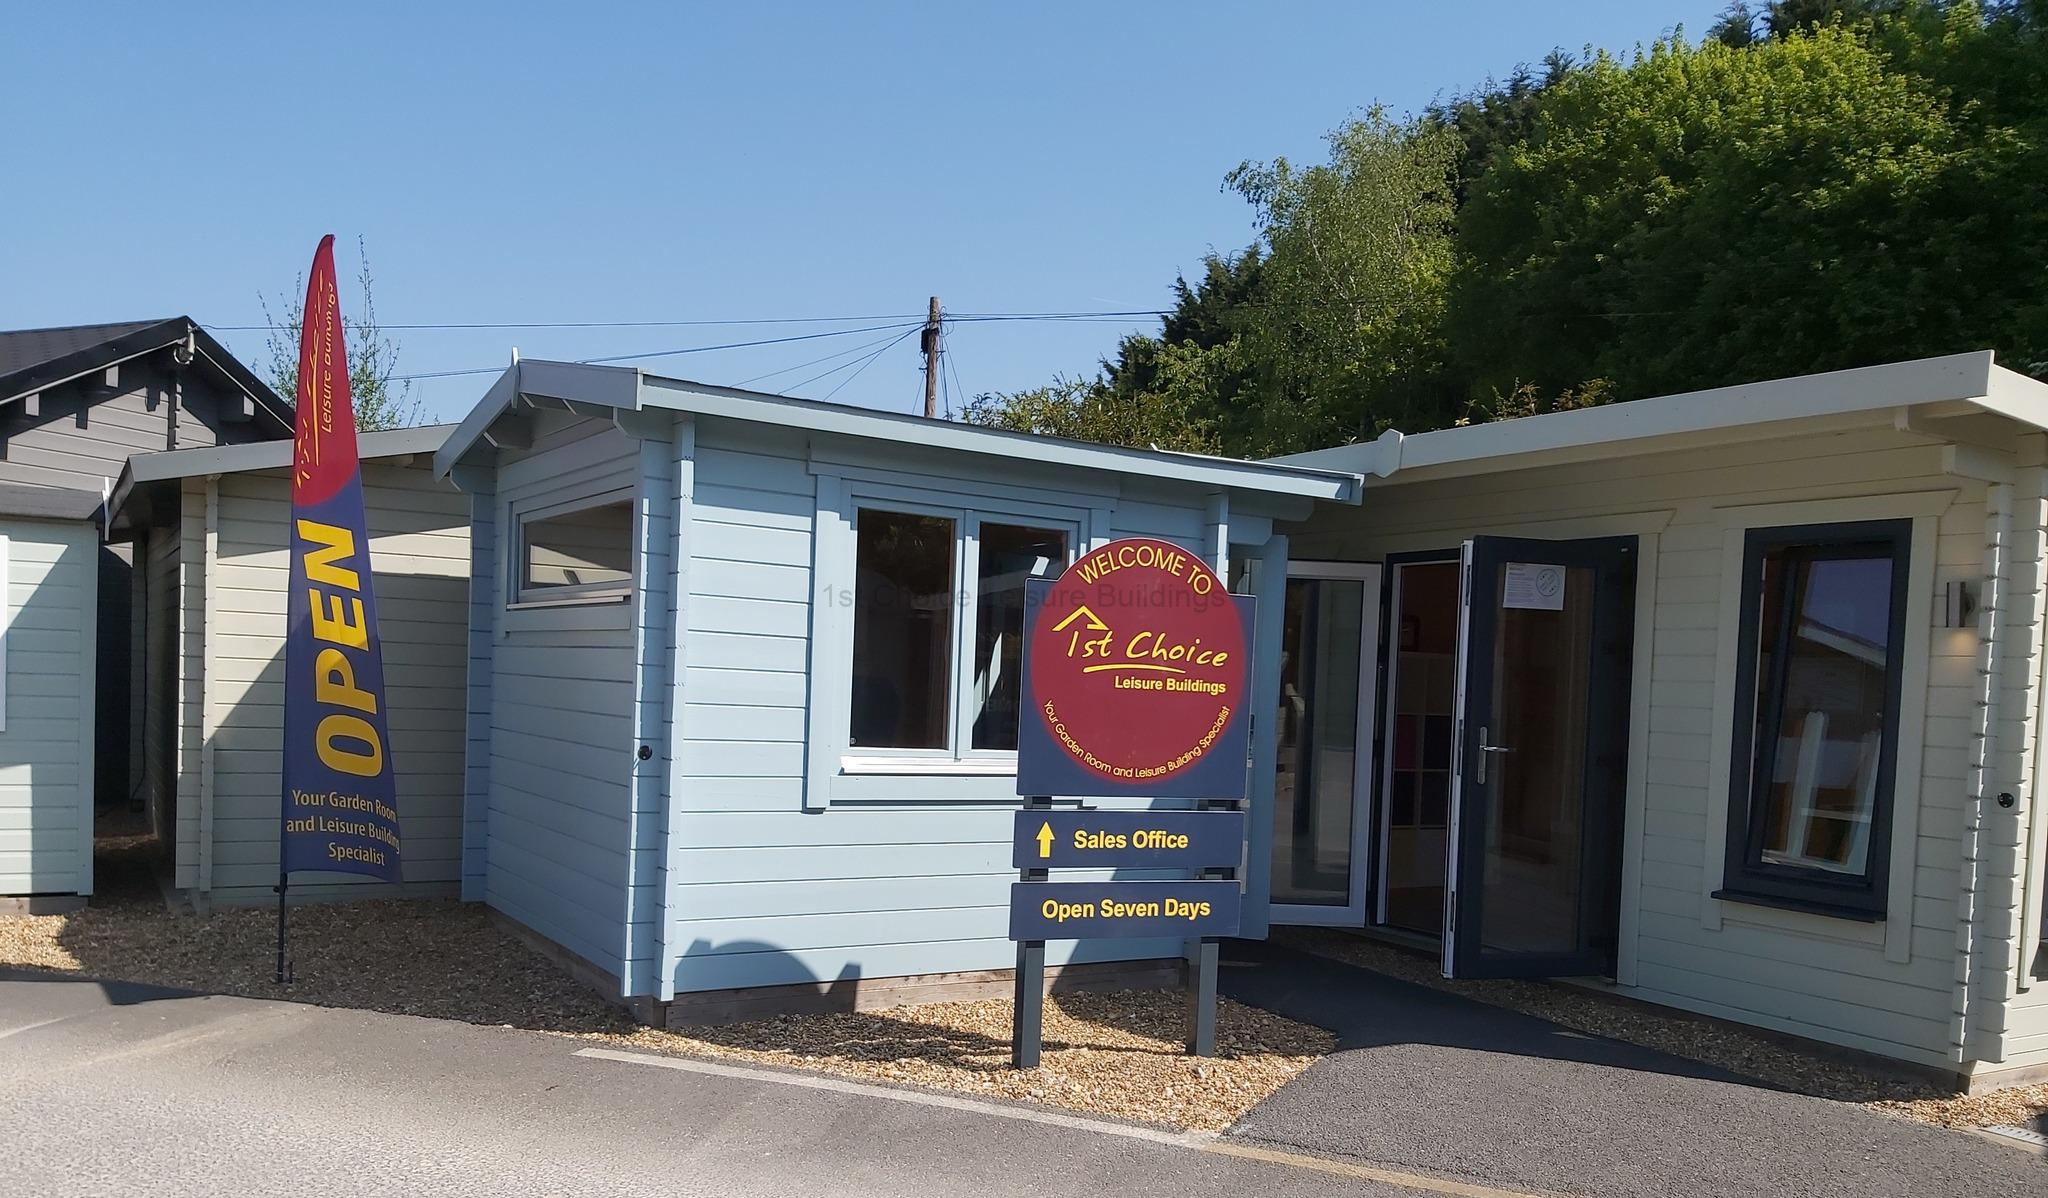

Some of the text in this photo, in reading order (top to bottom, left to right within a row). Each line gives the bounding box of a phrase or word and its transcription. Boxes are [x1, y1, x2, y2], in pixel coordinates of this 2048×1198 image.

[1076, 545, 1213, 595] WELCOME TO
[297, 519, 384, 778] OPEN
[1067, 630, 1228, 667] 1st Choice
[1114, 675, 1227, 696] Leisure Buildings
[1044, 700, 1231, 779] Your Garden Room and Leisure Building Specialist
[292, 789, 397, 824] Your Garden Room
[286, 816, 400, 855] and Leisure Building
[1073, 830, 1190, 849] Sales Office
[328, 842, 386, 867] Specialist
[1042, 898, 1211, 923] Open Seven Days
